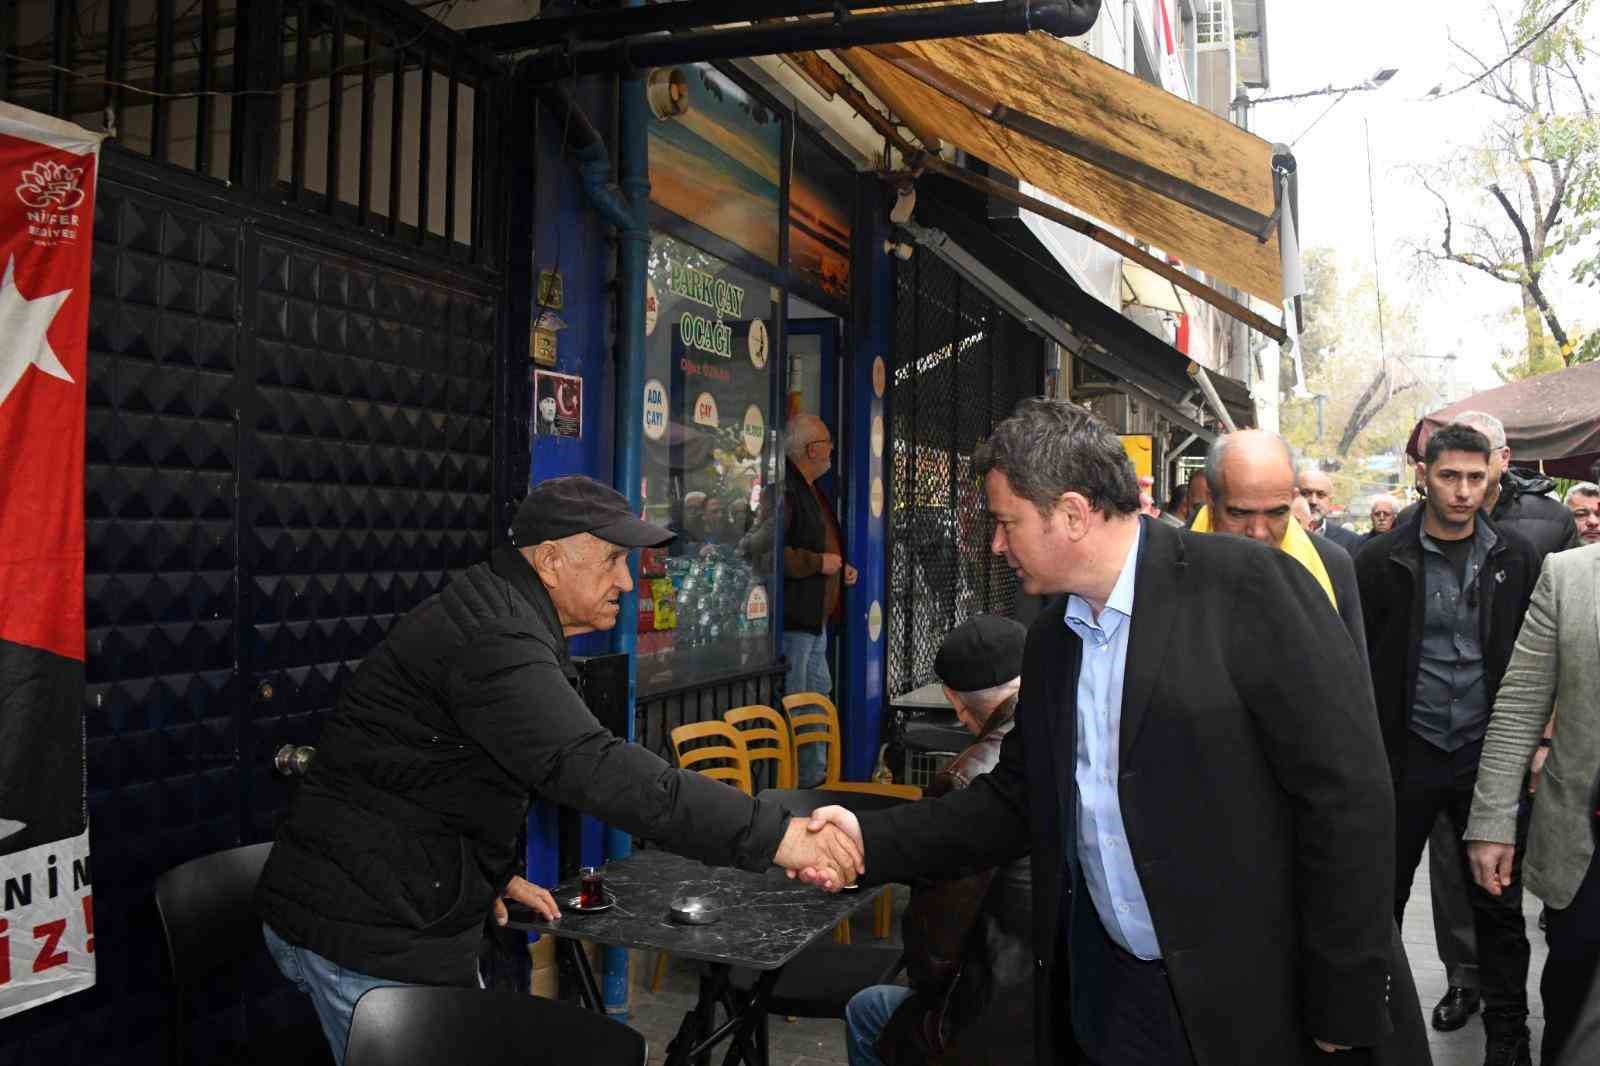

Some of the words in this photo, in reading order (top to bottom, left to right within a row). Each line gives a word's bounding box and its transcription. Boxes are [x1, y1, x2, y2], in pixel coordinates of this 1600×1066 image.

[671, 260, 714, 307] PARK
[714, 279, 744, 318] ÇAY
[681, 312, 731, 357] OCAĞI
[648, 389, 661, 405] ADA
[700, 402, 712, 420] ÇAY
